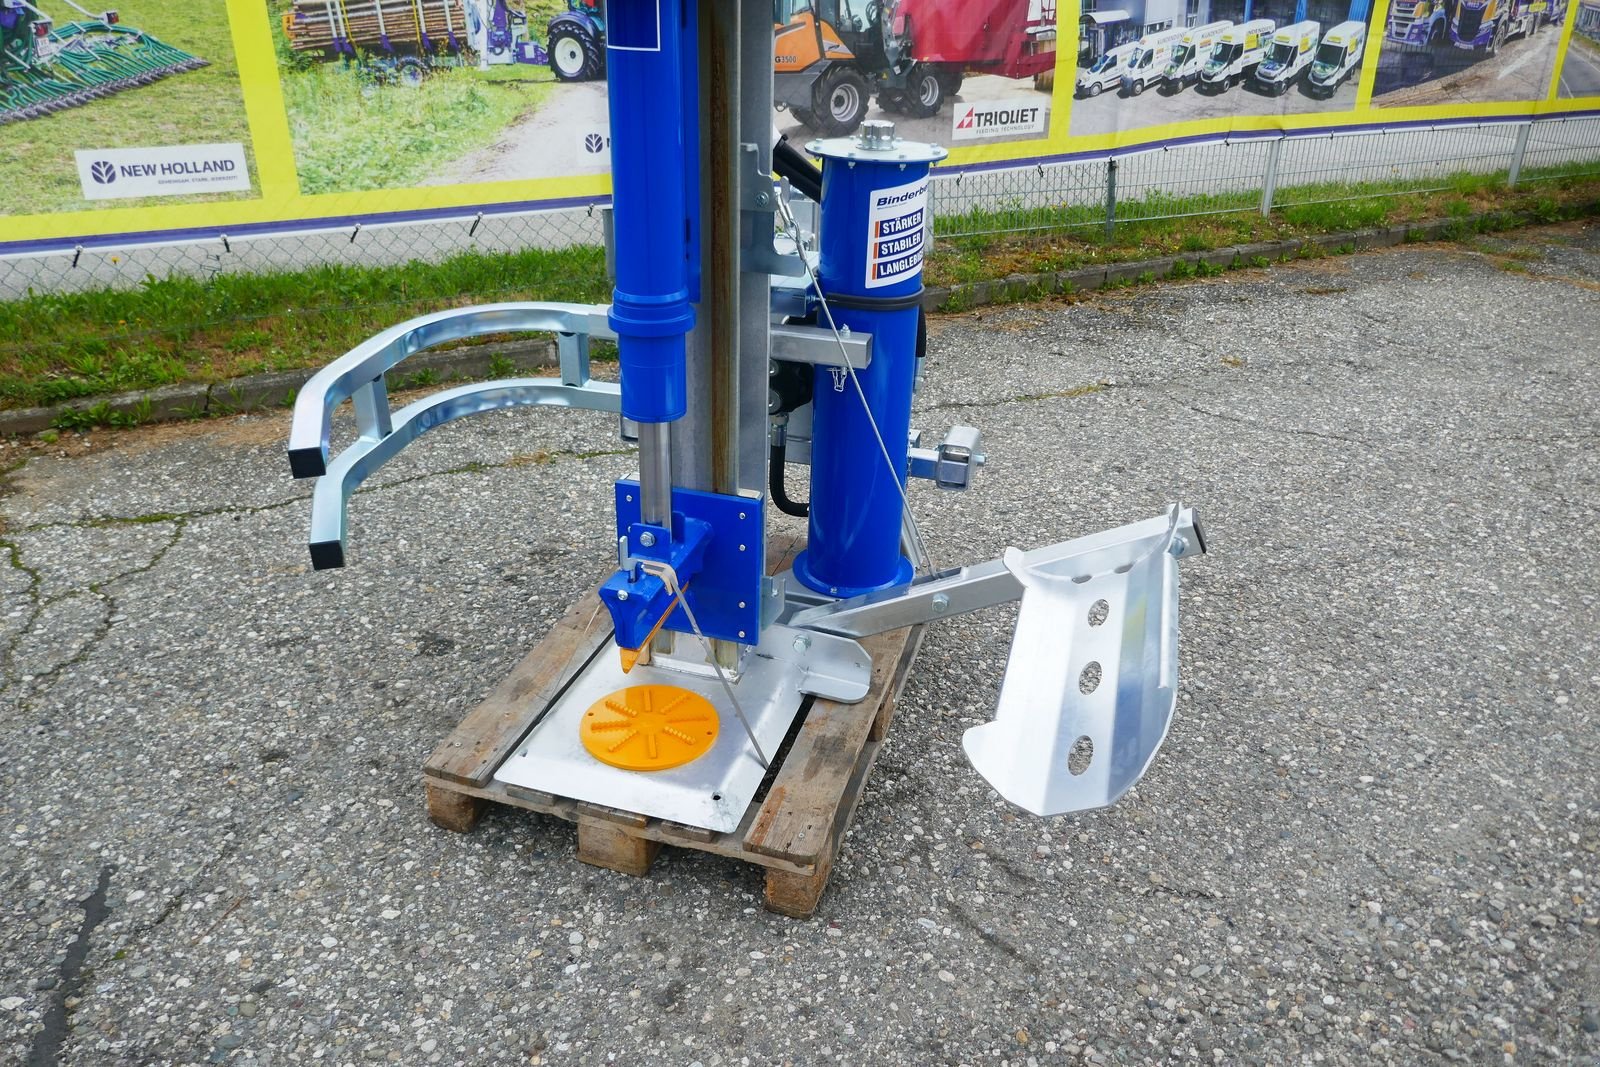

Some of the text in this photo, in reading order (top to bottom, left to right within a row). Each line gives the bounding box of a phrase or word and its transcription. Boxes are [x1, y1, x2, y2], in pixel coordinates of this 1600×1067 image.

[775, 55, 797, 63] G3500
[974, 107, 1039, 128] TRIOLIET
[1000, 124, 1035, 132] TECHNOLOGY
[120, 159, 235, 178] NEW HOLLAND
[882, 211, 922, 234] STÄRKER
[881, 232, 921, 255] STABILER
